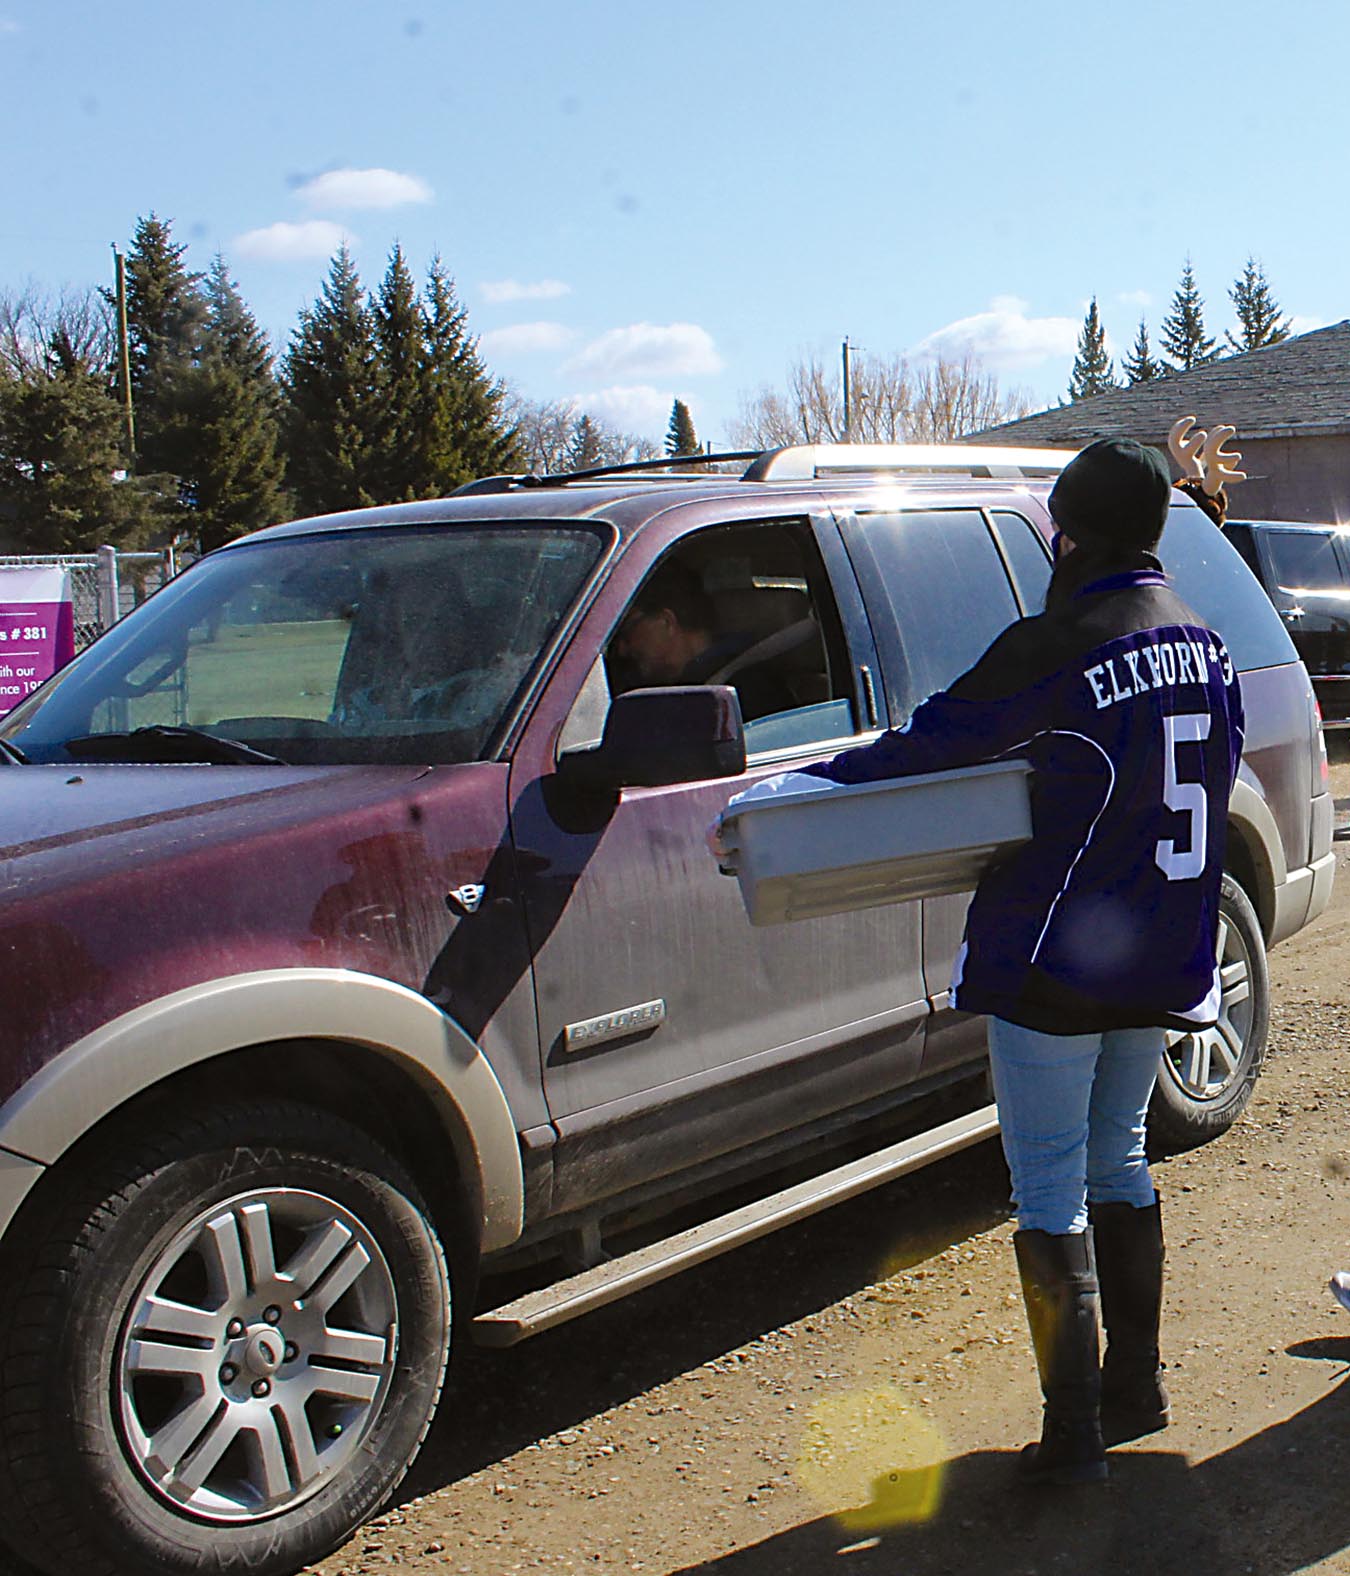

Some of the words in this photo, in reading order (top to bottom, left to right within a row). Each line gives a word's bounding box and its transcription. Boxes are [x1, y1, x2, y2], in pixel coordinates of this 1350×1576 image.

[23, 626, 47, 640] 381
[0, 664, 13, 677] ith
[16, 667, 35, 677] our
[1083, 642, 1209, 709] ELKHORN
[1208, 643, 1234, 686] #3
[0, 685, 20, 695] nce
[1155, 713, 1211, 881] 5
